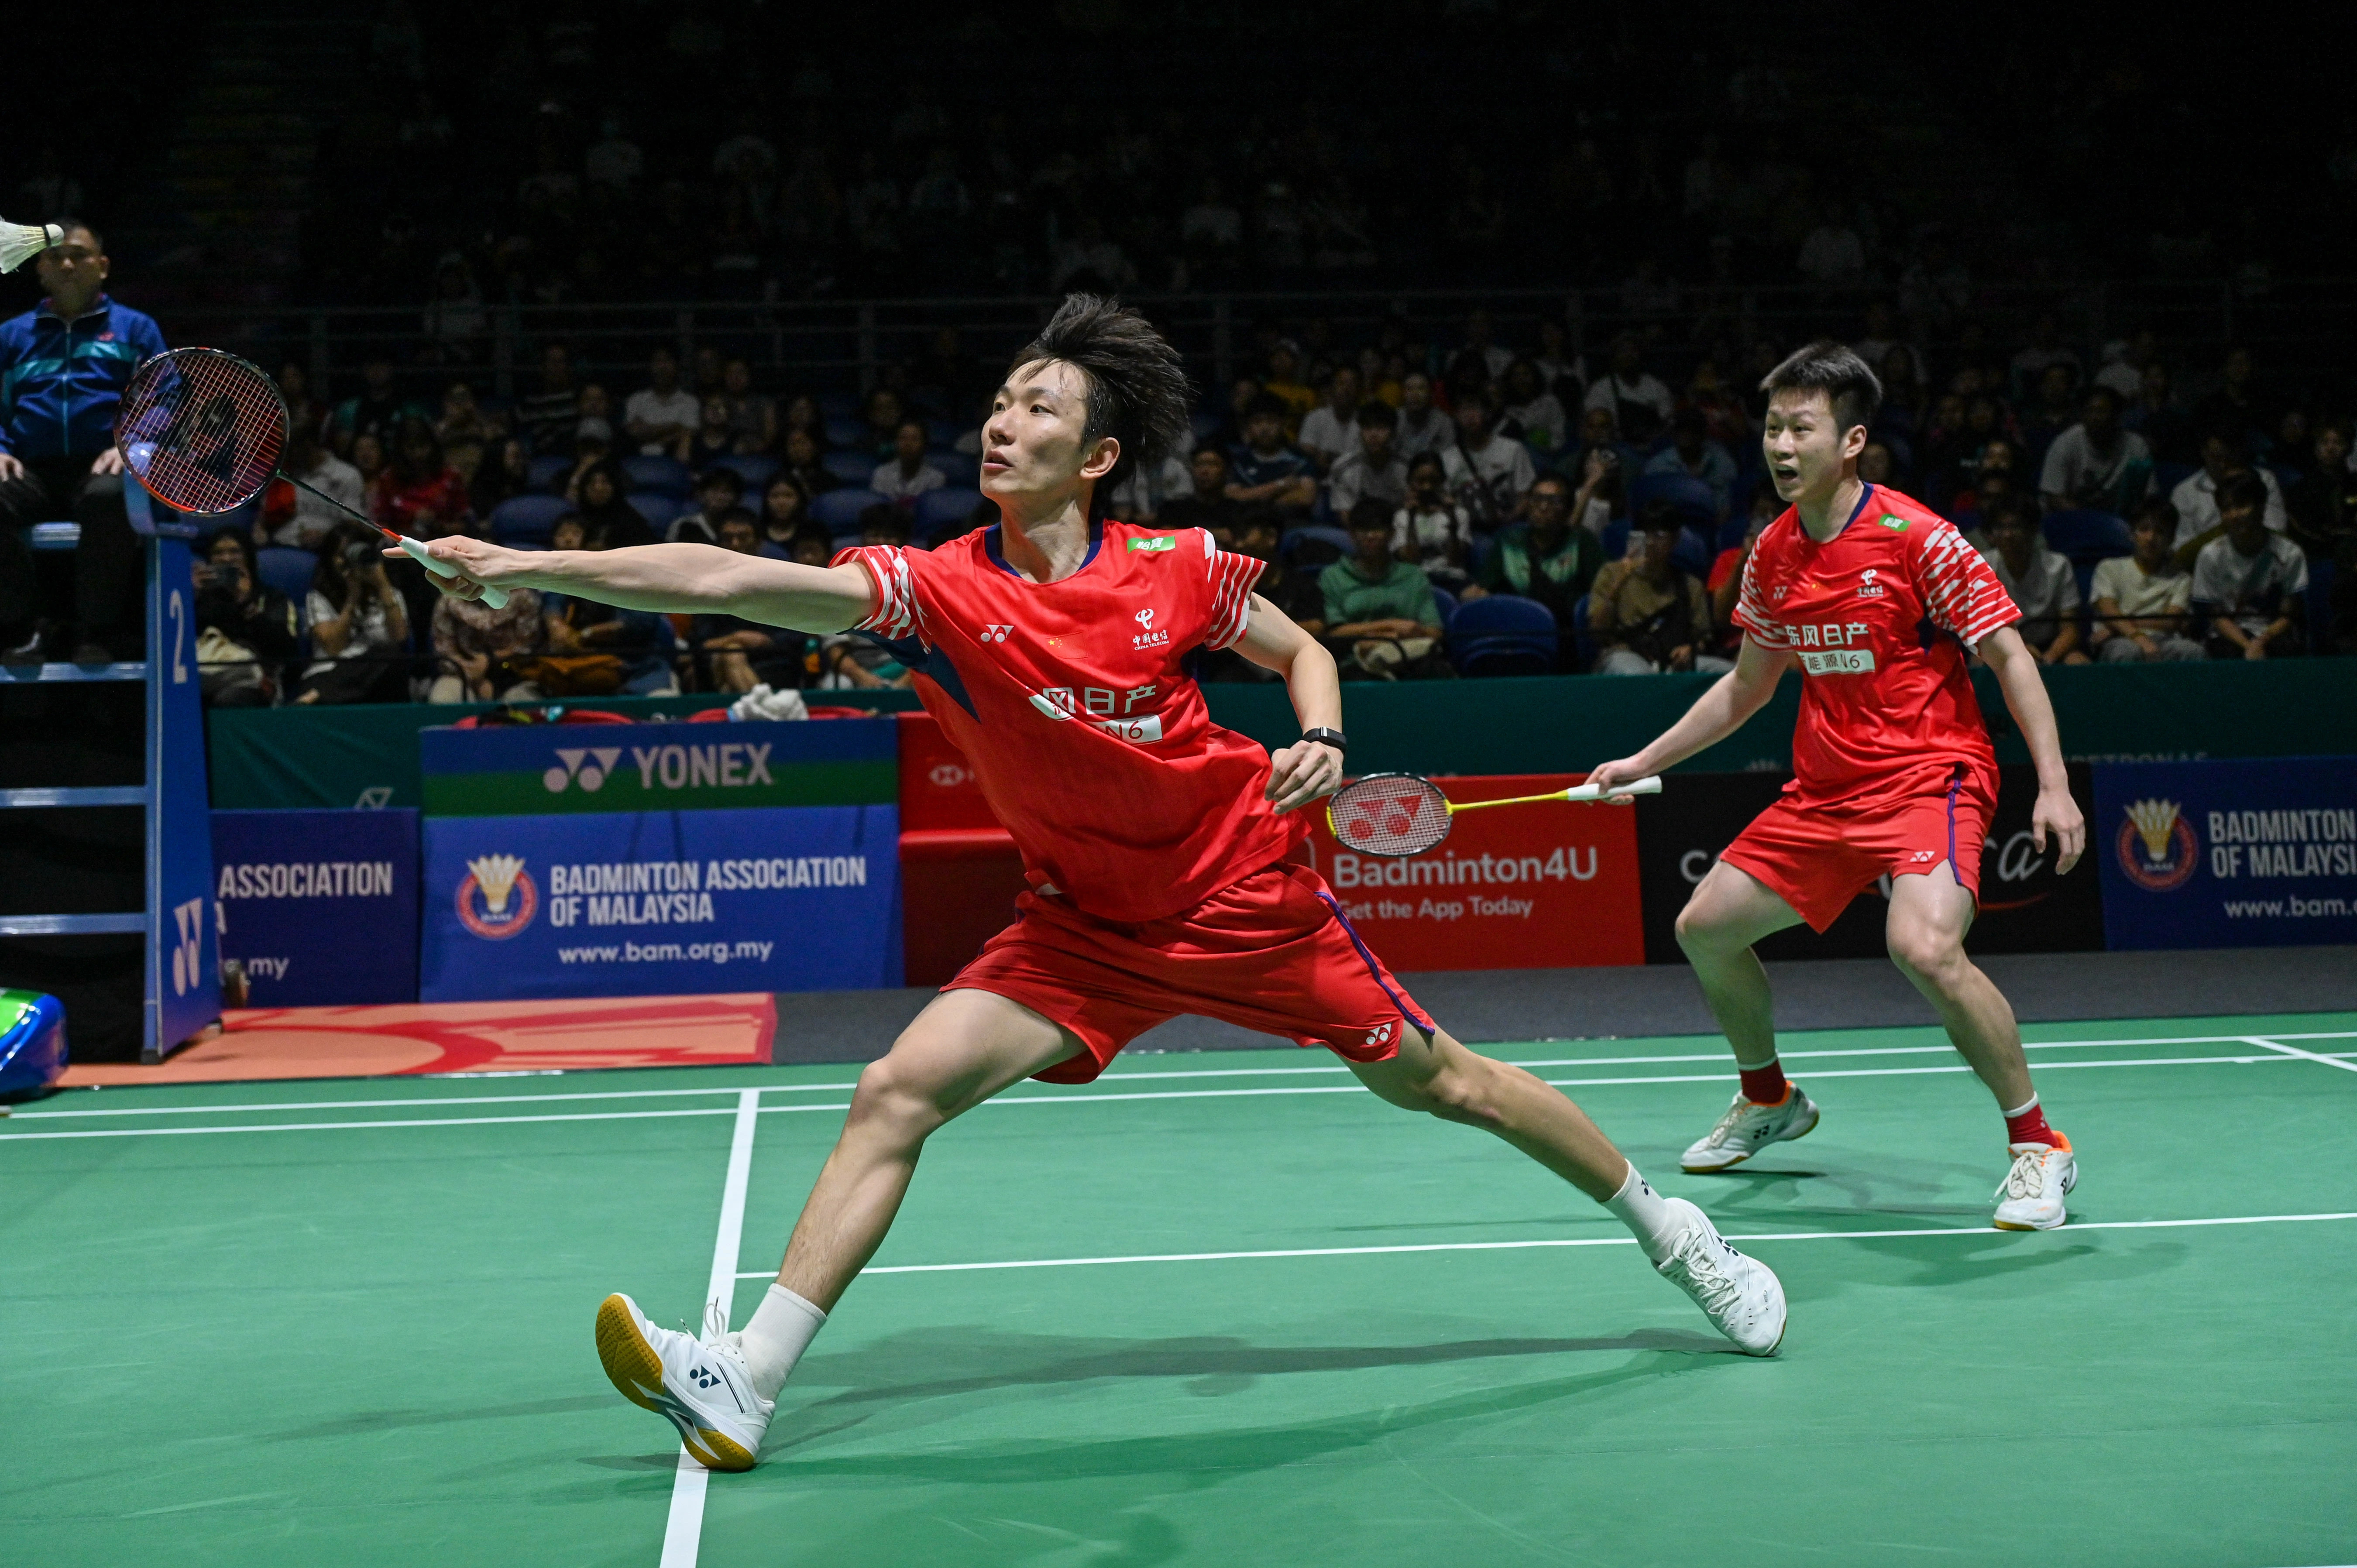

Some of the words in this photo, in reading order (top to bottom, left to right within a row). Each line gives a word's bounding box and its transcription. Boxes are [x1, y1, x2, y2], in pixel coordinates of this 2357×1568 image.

[169, 589, 188, 684] 2
[1133, 629, 1168, 646] 中国电信
[632, 743, 773, 789] YONEX
[2208, 809, 2357, 844] BADMINTON
[218, 861, 393, 899] ASSOCIATION
[550, 861, 699, 897] BADMINTON
[705, 855, 867, 891] ASSOCIATION
[1333, 846, 1598, 888] Badminton4U
[2211, 845, 2243, 879] OF
[550, 897, 581, 928] OF
[588, 892, 715, 926] MALAYSIA
[1338, 899, 1373, 920] Get
[1377, 899, 1413, 919] the
[1418, 897, 1464, 921] App
[1467, 895, 1534, 919] Today
[558, 940, 774, 965] www.bam.org.my
